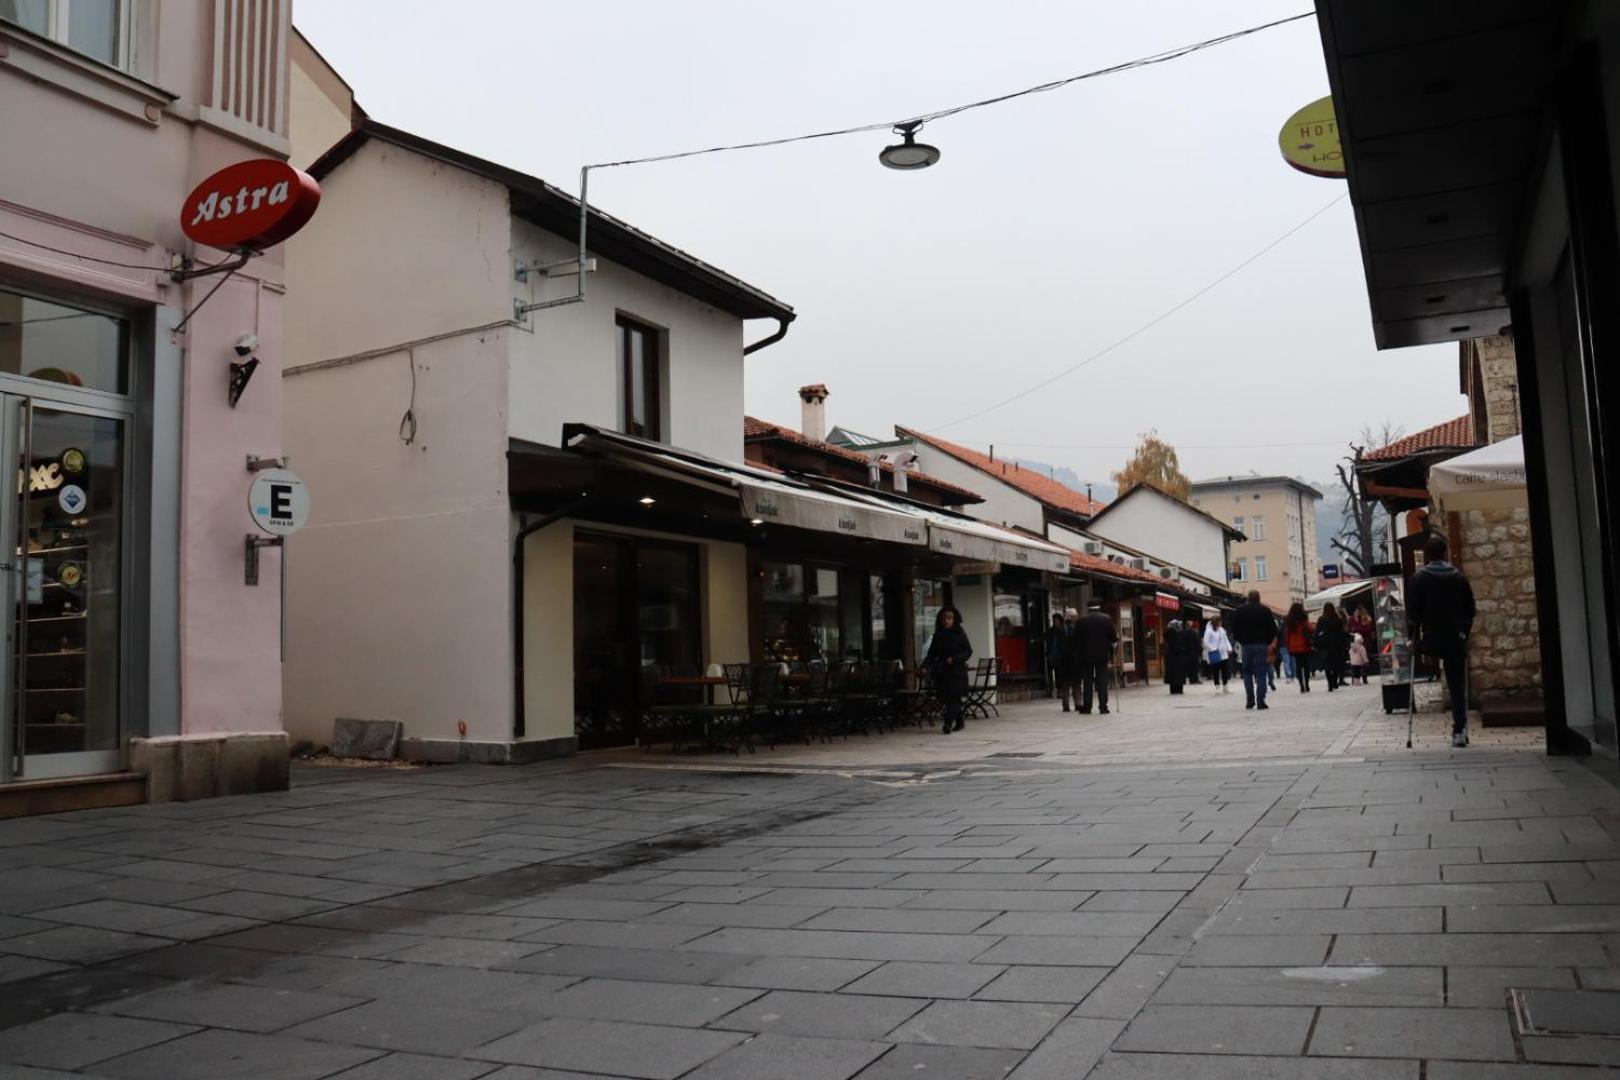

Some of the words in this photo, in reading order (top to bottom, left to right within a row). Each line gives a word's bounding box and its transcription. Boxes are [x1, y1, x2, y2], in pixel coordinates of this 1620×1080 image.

[1300, 123, 1334, 139] HOT
[1313, 151, 1342, 163] HO
[191, 180, 289, 226] Astra
[271, 484, 292, 519] E
